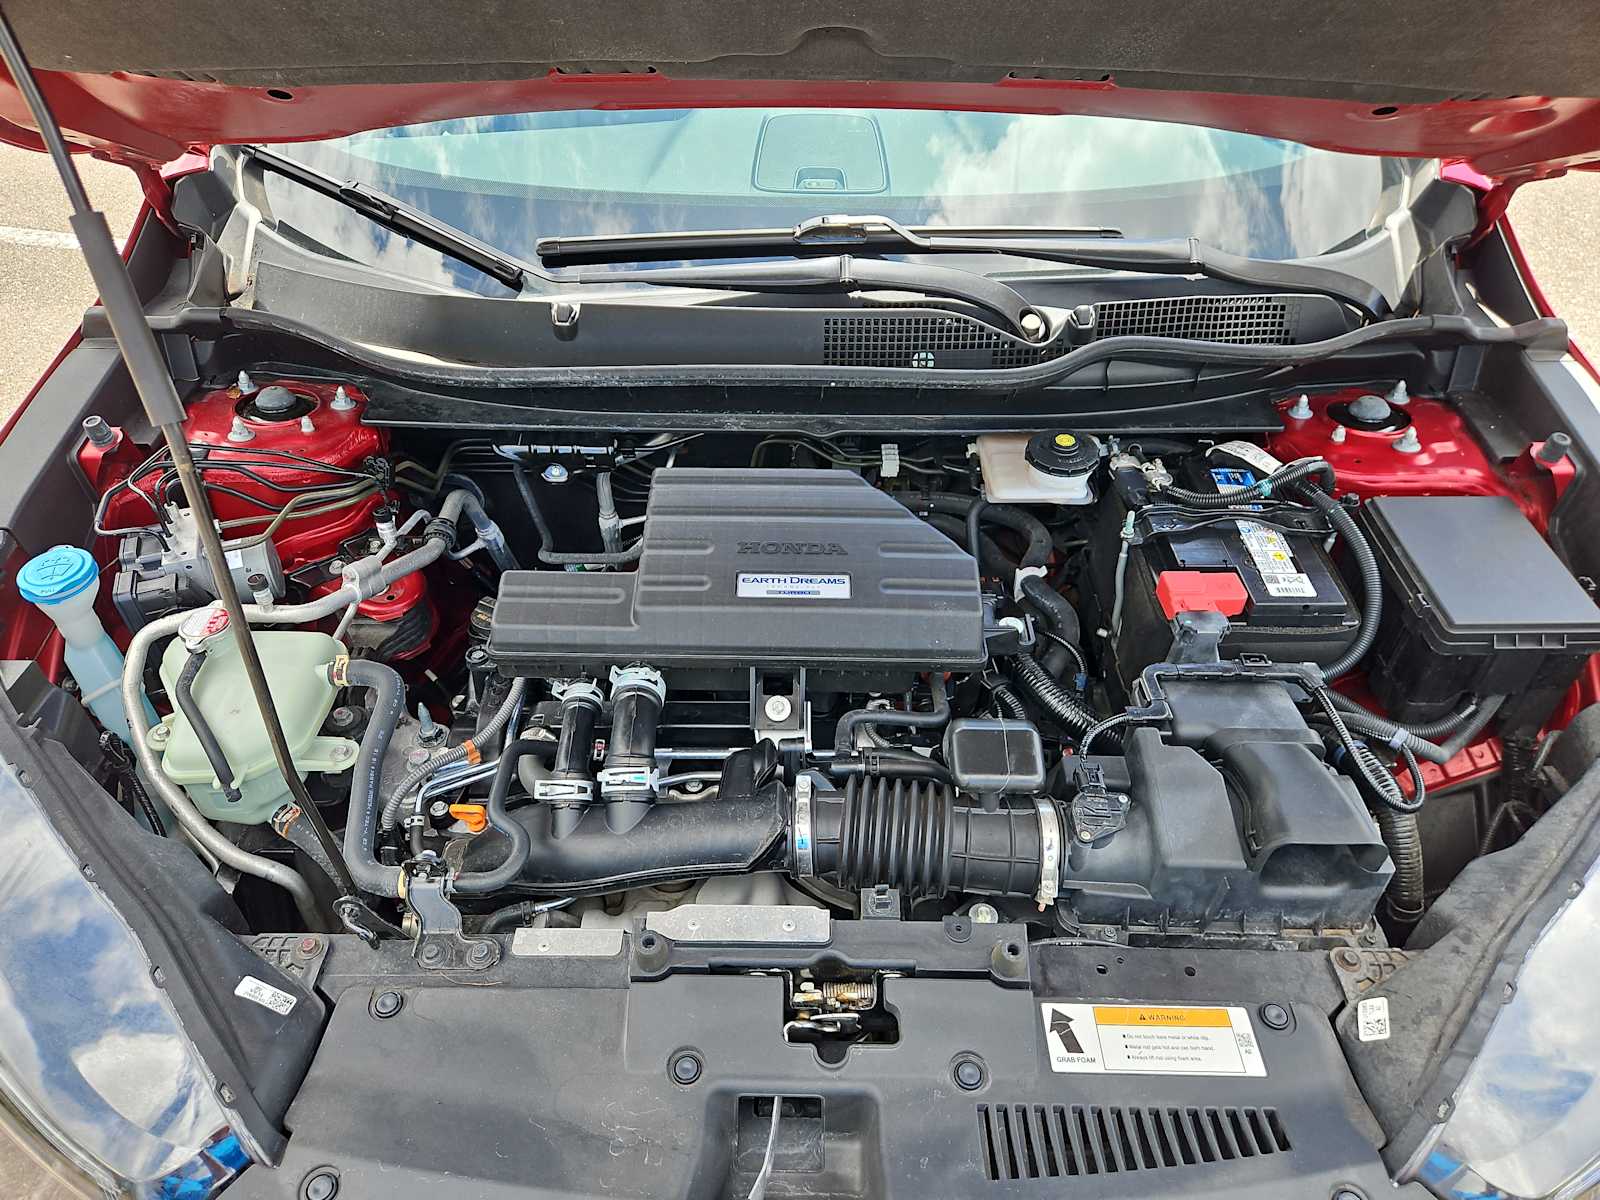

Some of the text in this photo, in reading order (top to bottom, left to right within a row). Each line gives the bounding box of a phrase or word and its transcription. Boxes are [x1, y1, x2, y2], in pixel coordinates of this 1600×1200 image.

[736, 541, 849, 556] HONDA
[741, 576, 847, 585] EARTH DREAMS
[1148, 1014, 1186, 1022] WARNING
